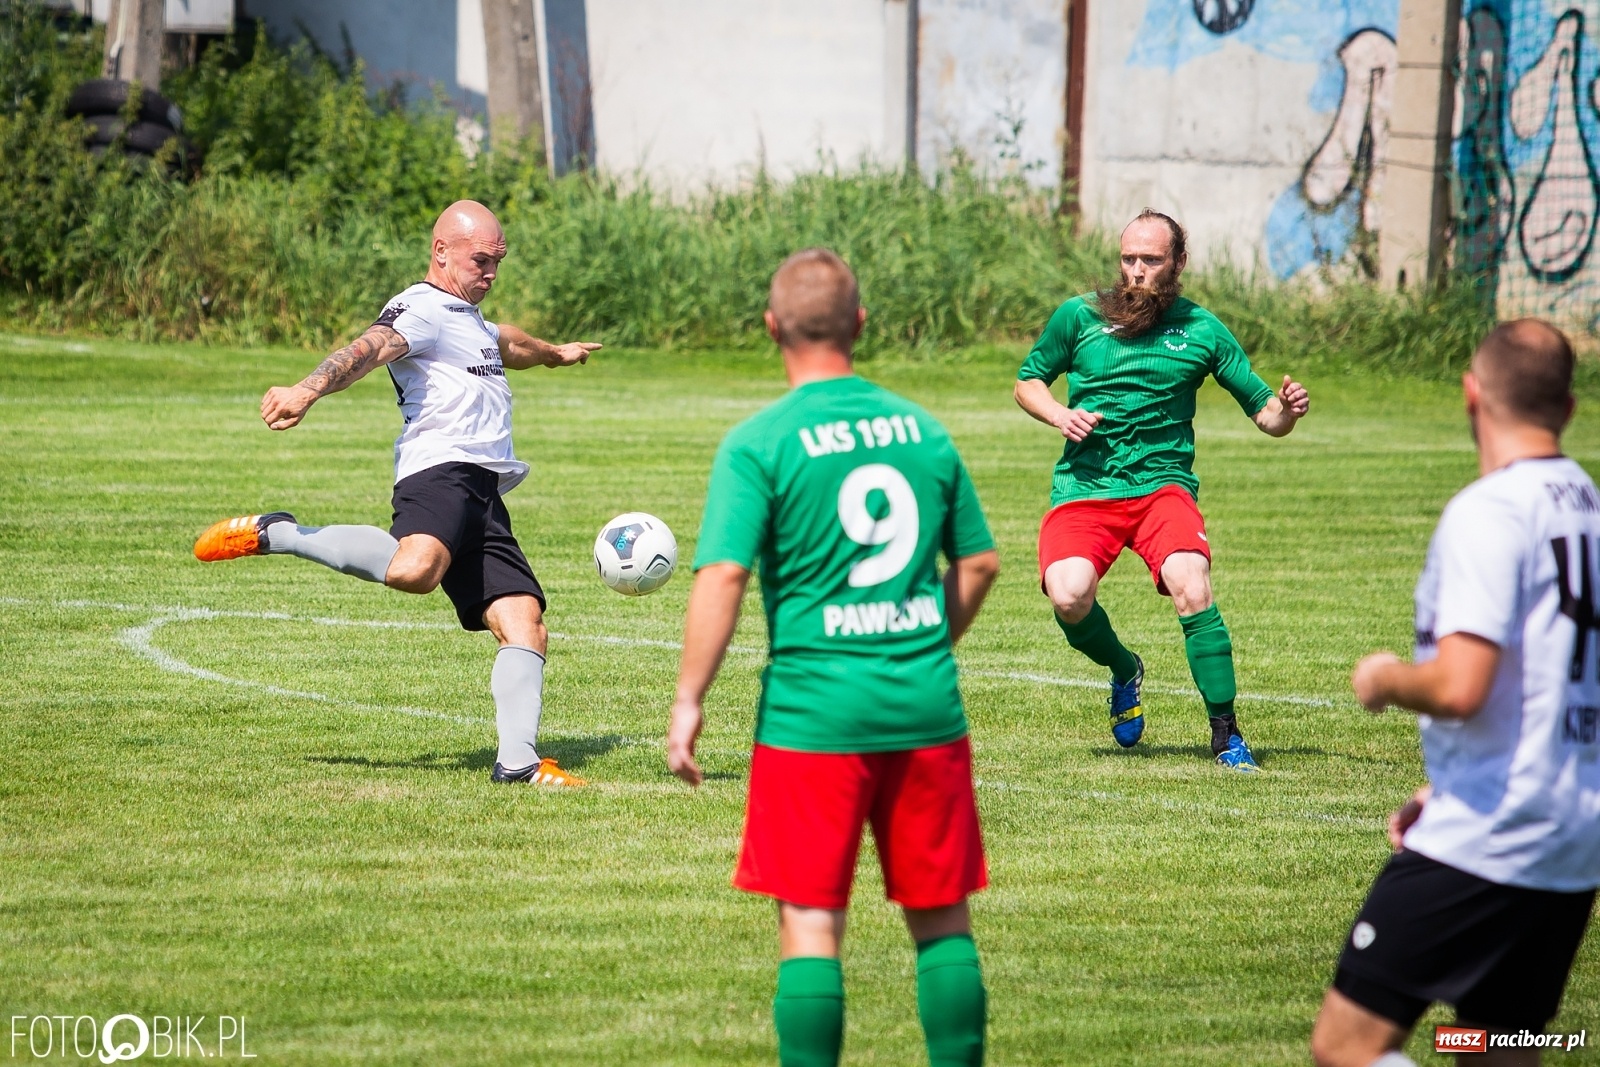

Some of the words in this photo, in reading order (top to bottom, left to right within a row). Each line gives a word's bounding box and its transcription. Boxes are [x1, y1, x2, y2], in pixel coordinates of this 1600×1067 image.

[800, 421, 856, 458] LKS
[855, 414, 922, 449] 1911
[837, 463, 919, 588] 9
